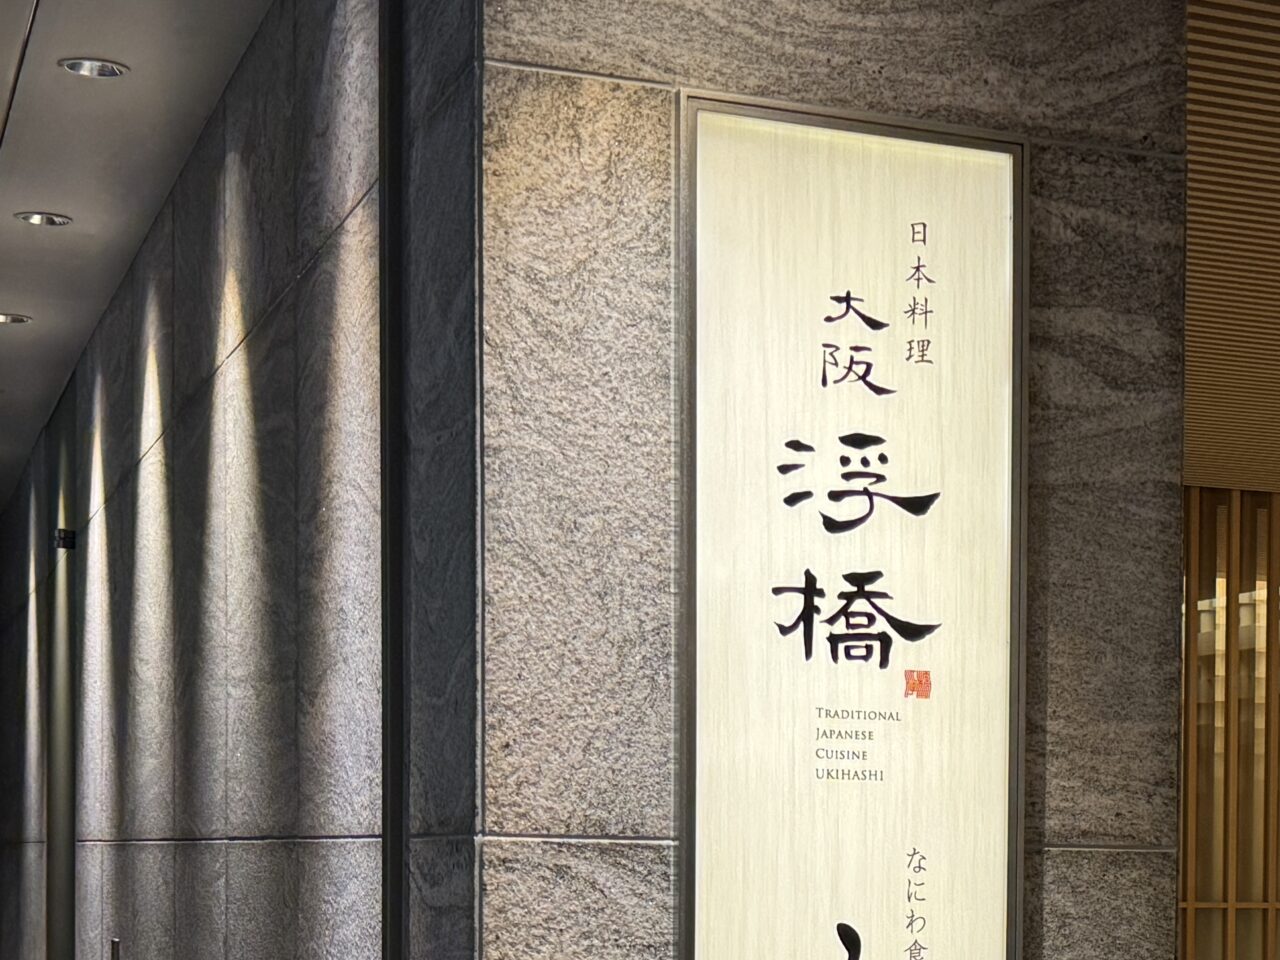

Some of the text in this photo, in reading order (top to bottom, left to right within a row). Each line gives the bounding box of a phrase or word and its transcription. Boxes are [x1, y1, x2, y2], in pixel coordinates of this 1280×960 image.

[904, 221, 936, 365] 日本料理
[815, 768, 884, 782] UKIHASHI
